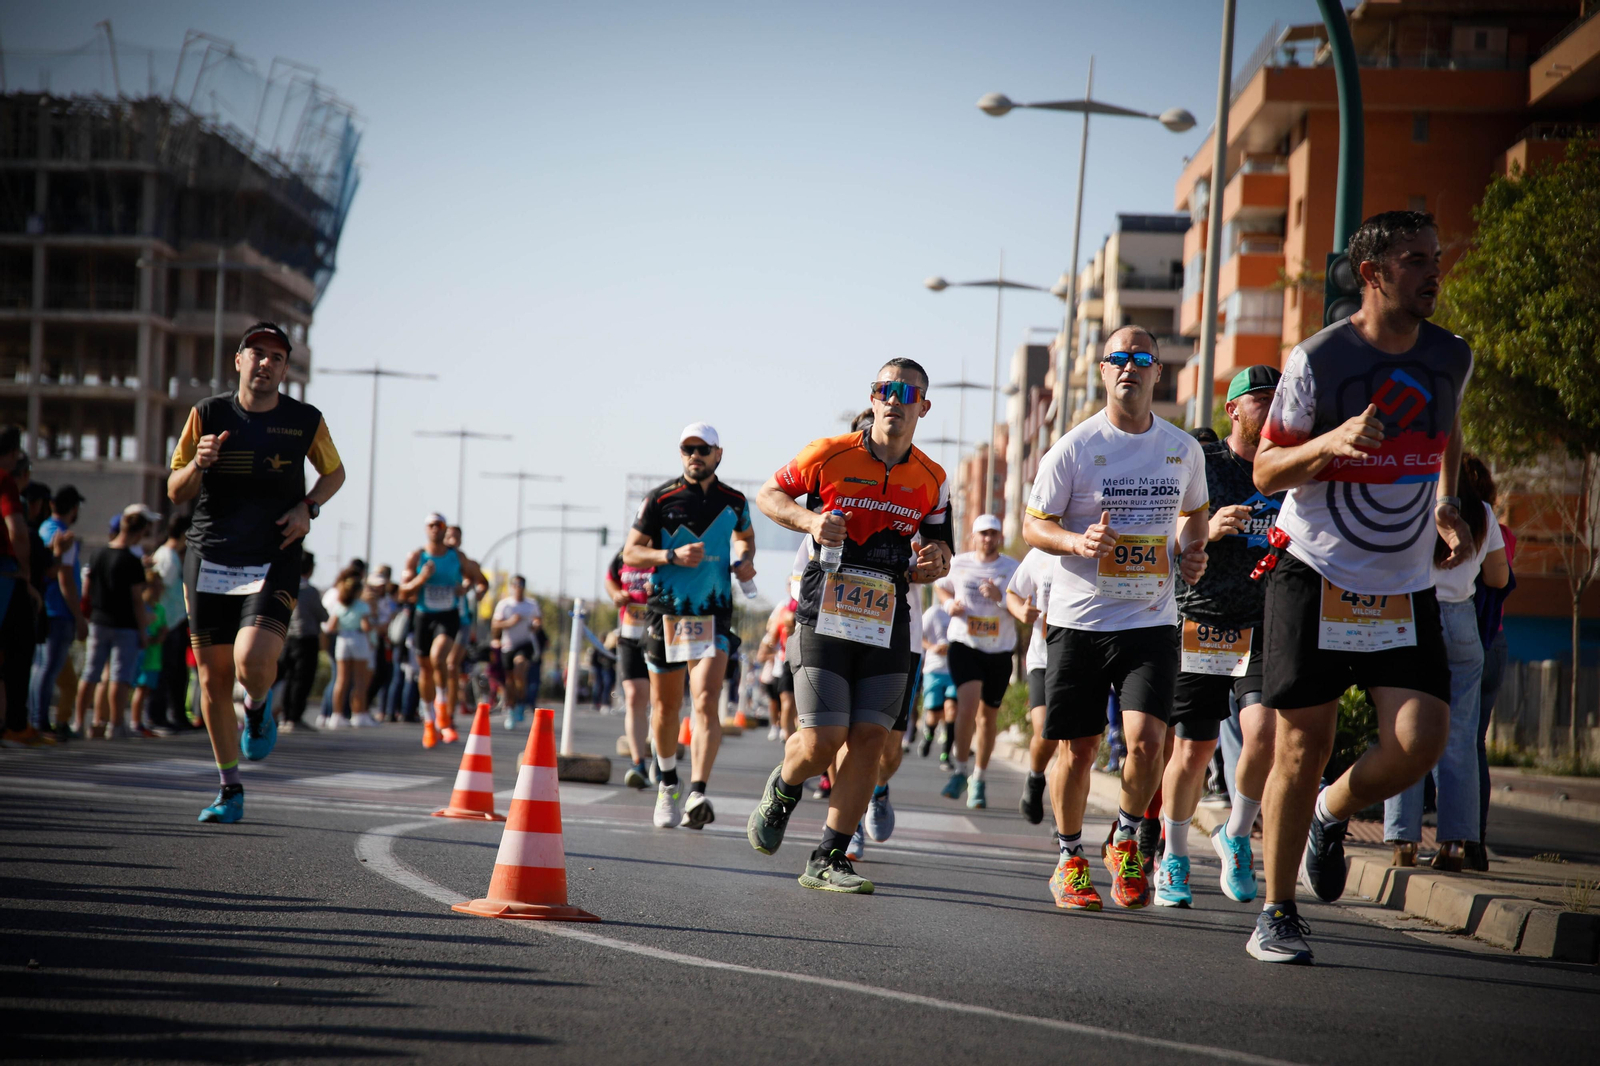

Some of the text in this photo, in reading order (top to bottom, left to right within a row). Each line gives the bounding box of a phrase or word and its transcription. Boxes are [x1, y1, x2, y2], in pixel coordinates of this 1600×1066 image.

[1102, 477, 1180, 486] Medio Maratón
[1102, 485, 1180, 497] Almería 2024
[892, 520, 914, 533] TEAM
[1114, 545, 1157, 565] 954
[832, 583, 889, 612] 1414
[836, 603, 880, 617] ANTONIO PARIS
[1351, 607, 1382, 616] VILCHEZ
[674, 621, 704, 636] 955
[1196, 623, 1238, 645] 958
